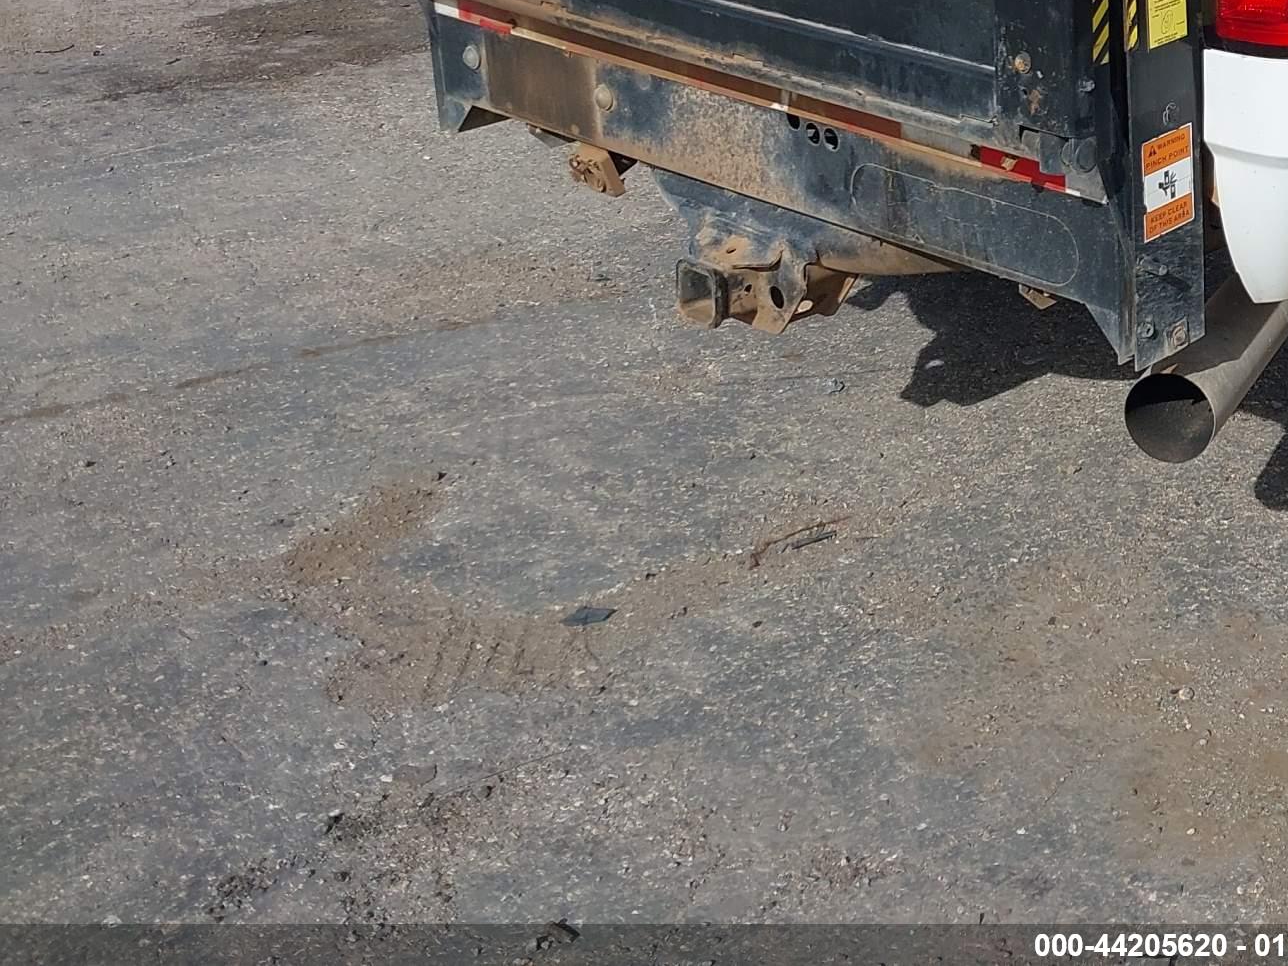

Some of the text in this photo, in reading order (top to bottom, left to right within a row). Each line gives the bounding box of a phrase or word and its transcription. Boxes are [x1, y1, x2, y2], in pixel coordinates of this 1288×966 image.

[1157, 133, 1186, 150] WARNING
[1145, 145, 1189, 171] PINCH POINT
[1150, 201, 1188, 224] KEEP CLEAR
[1159, 218, 1173, 229] THIS
